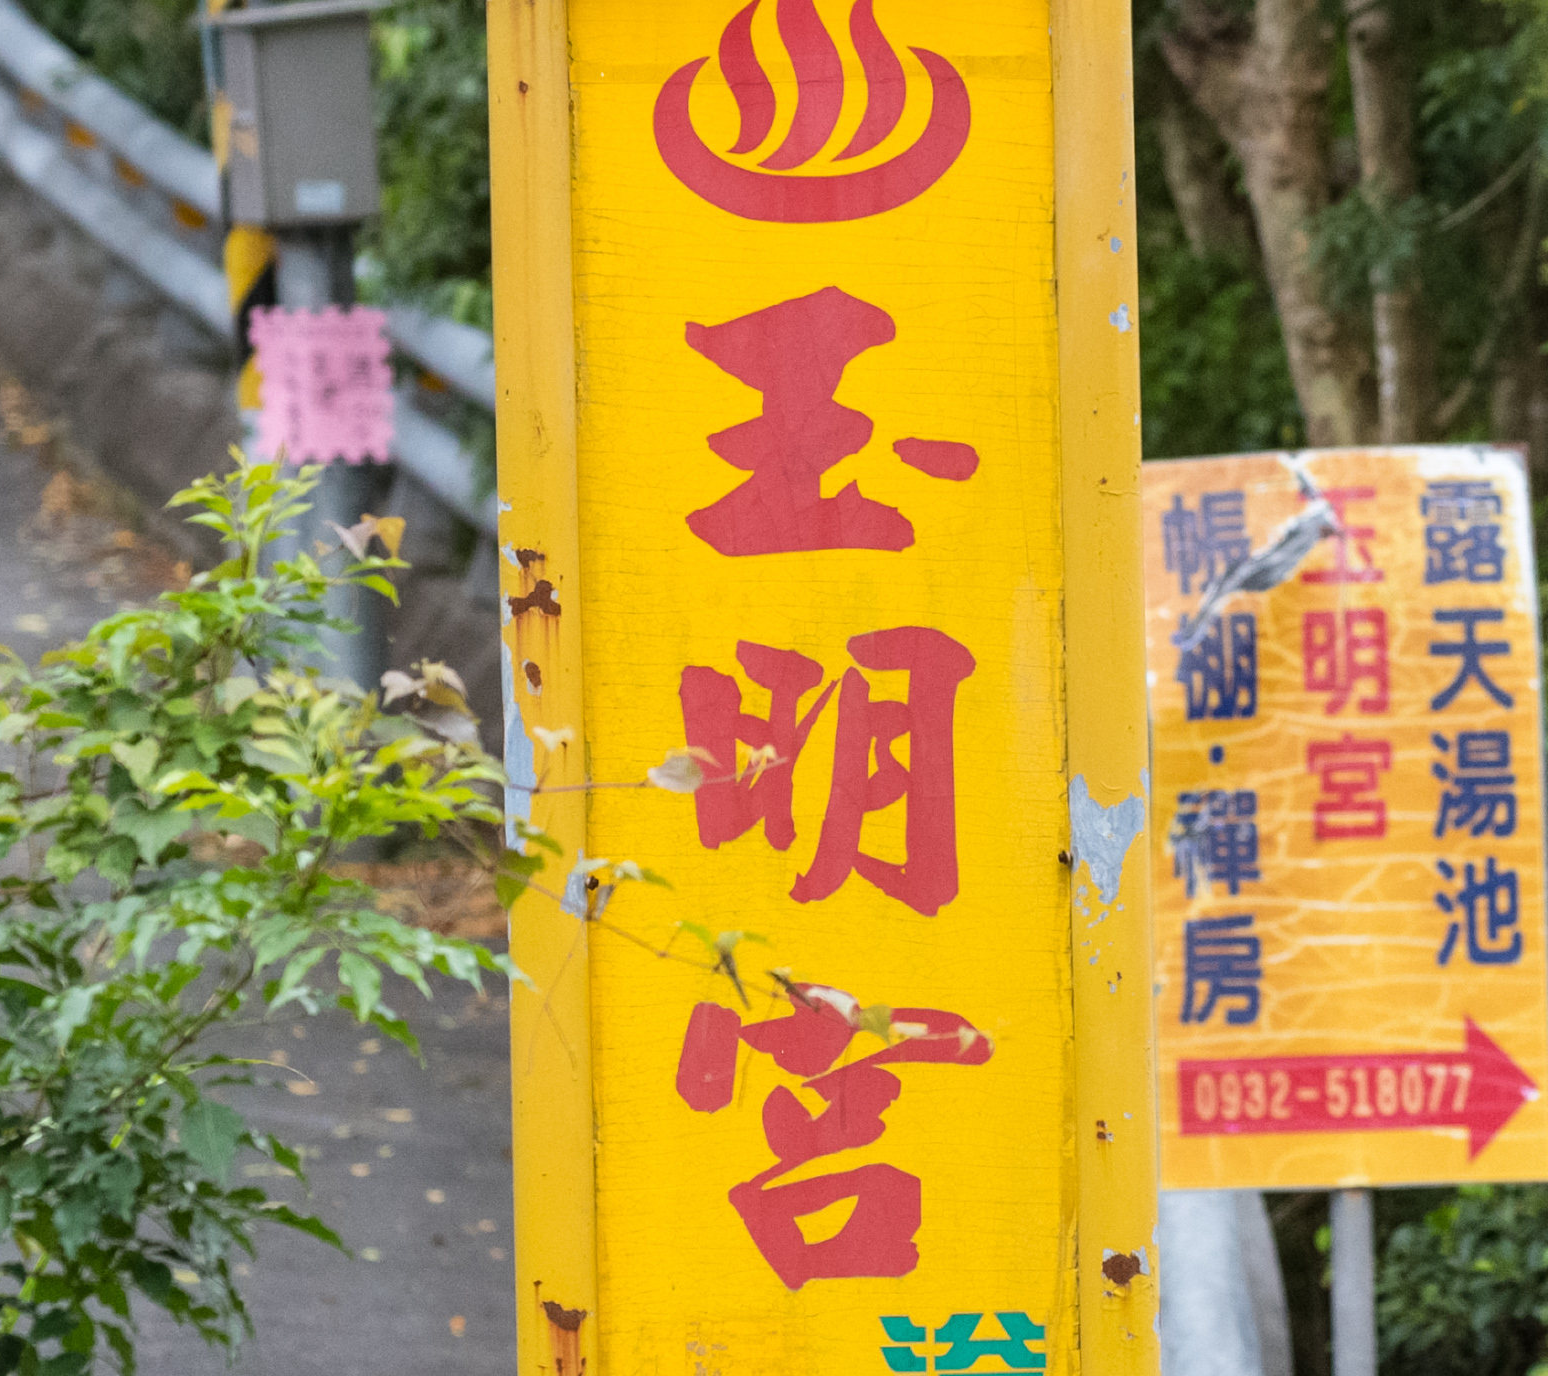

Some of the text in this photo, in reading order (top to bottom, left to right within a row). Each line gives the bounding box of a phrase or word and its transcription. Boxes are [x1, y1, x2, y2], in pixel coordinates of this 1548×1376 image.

[676, 284, 994, 1291] 玉明宮
[1297, 485, 1393, 841] 玉明宮
[1418, 480, 1524, 967] 露天湯池
[1194, 1063, 1475, 1121] 0932-518077
